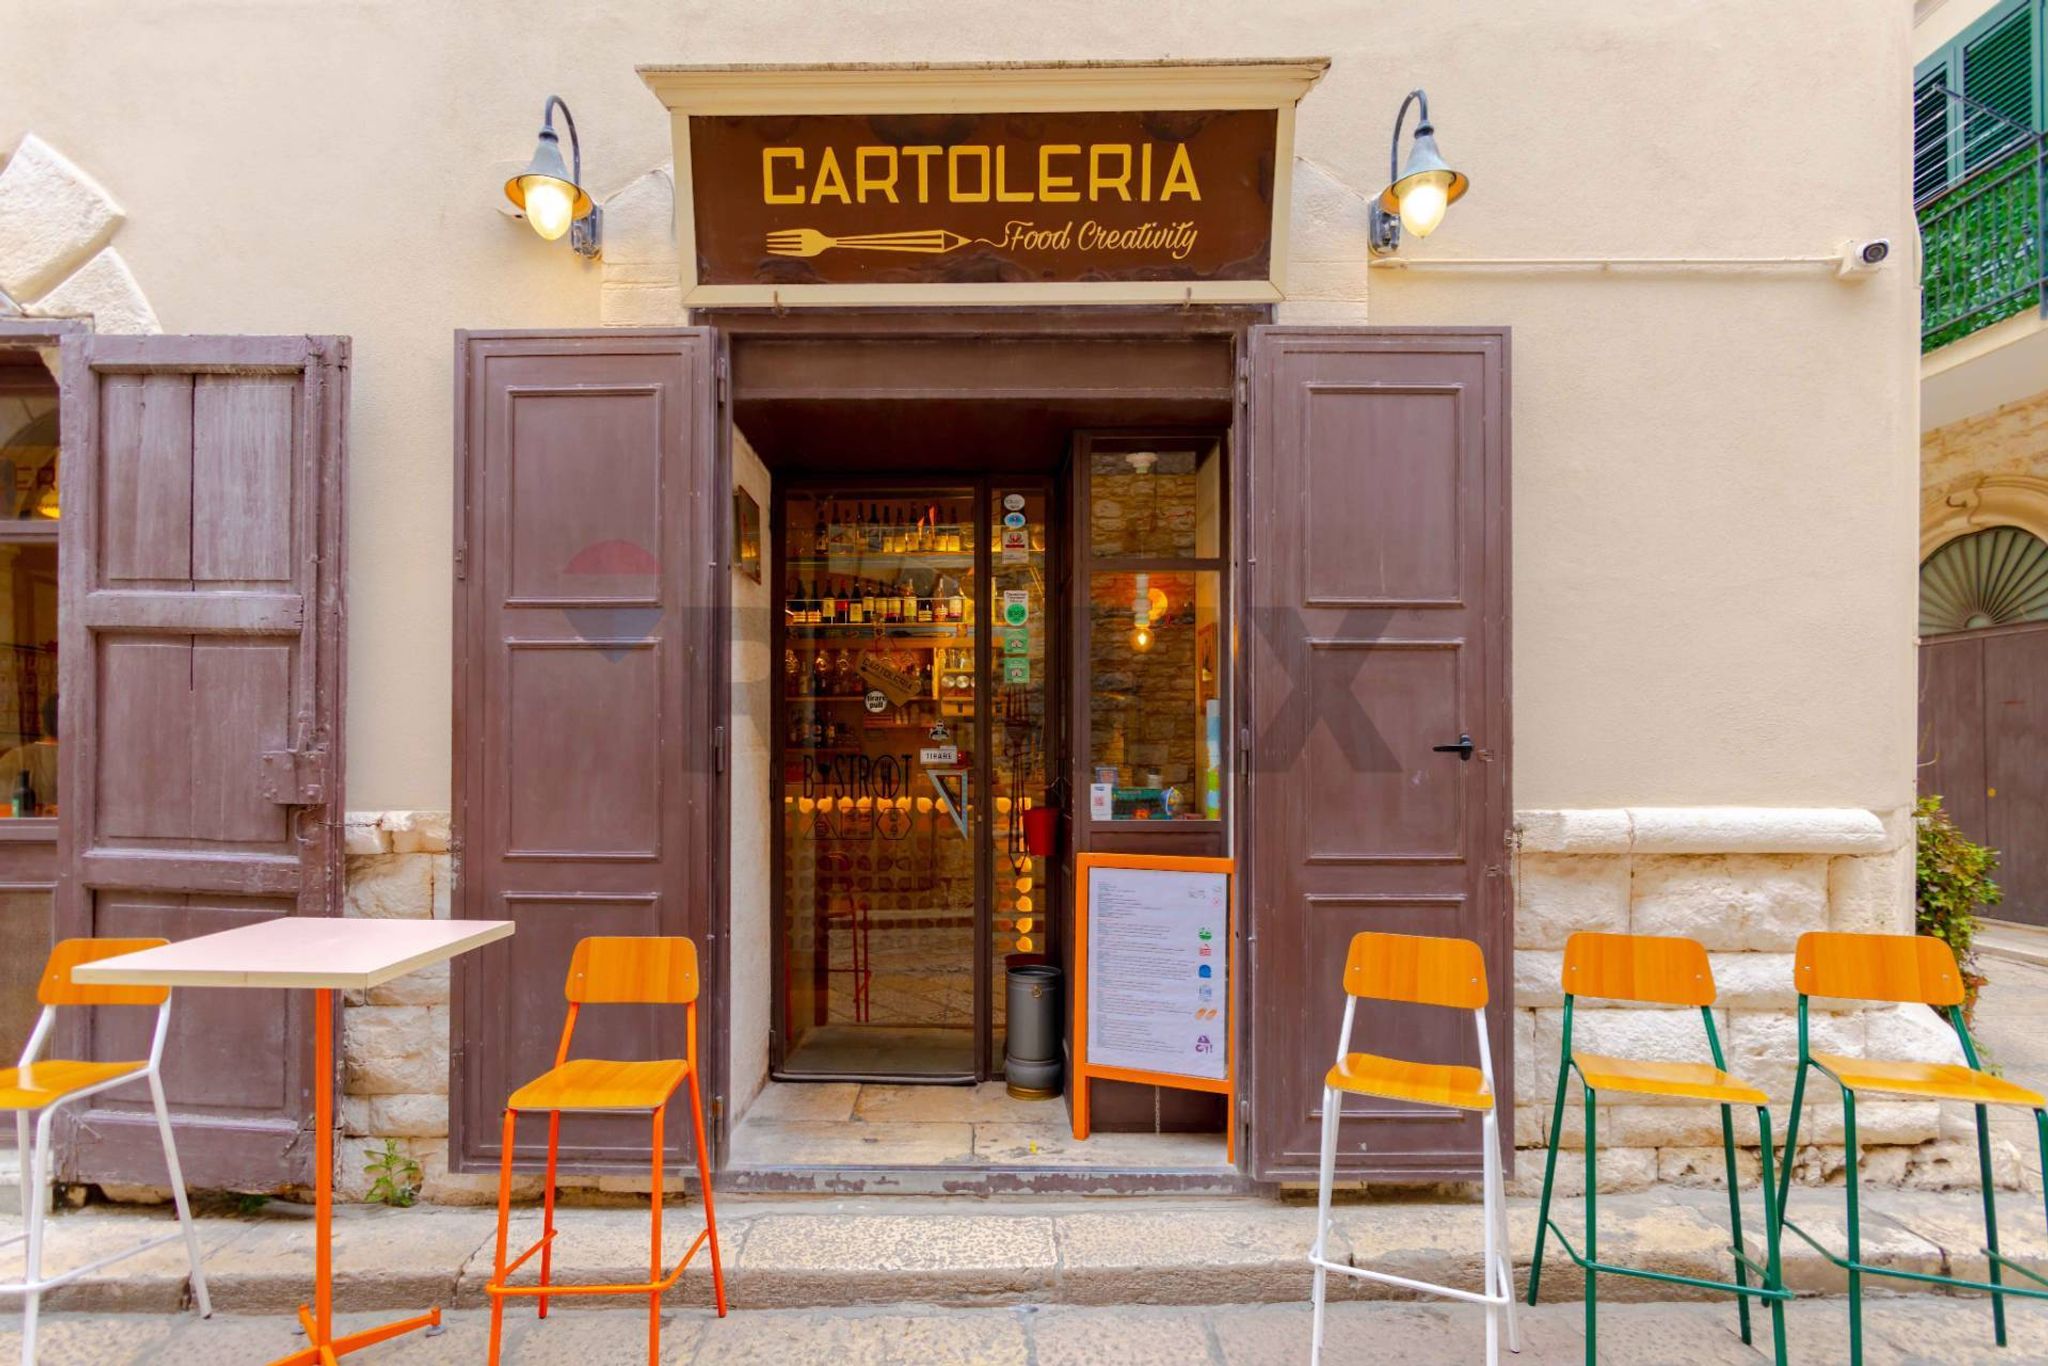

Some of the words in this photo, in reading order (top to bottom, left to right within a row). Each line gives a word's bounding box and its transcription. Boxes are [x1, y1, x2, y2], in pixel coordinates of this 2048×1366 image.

[761, 142, 1203, 204] CARTOLERIA
[1003, 219, 1072, 252] Food
[1078, 218, 1199, 259] Creativity
